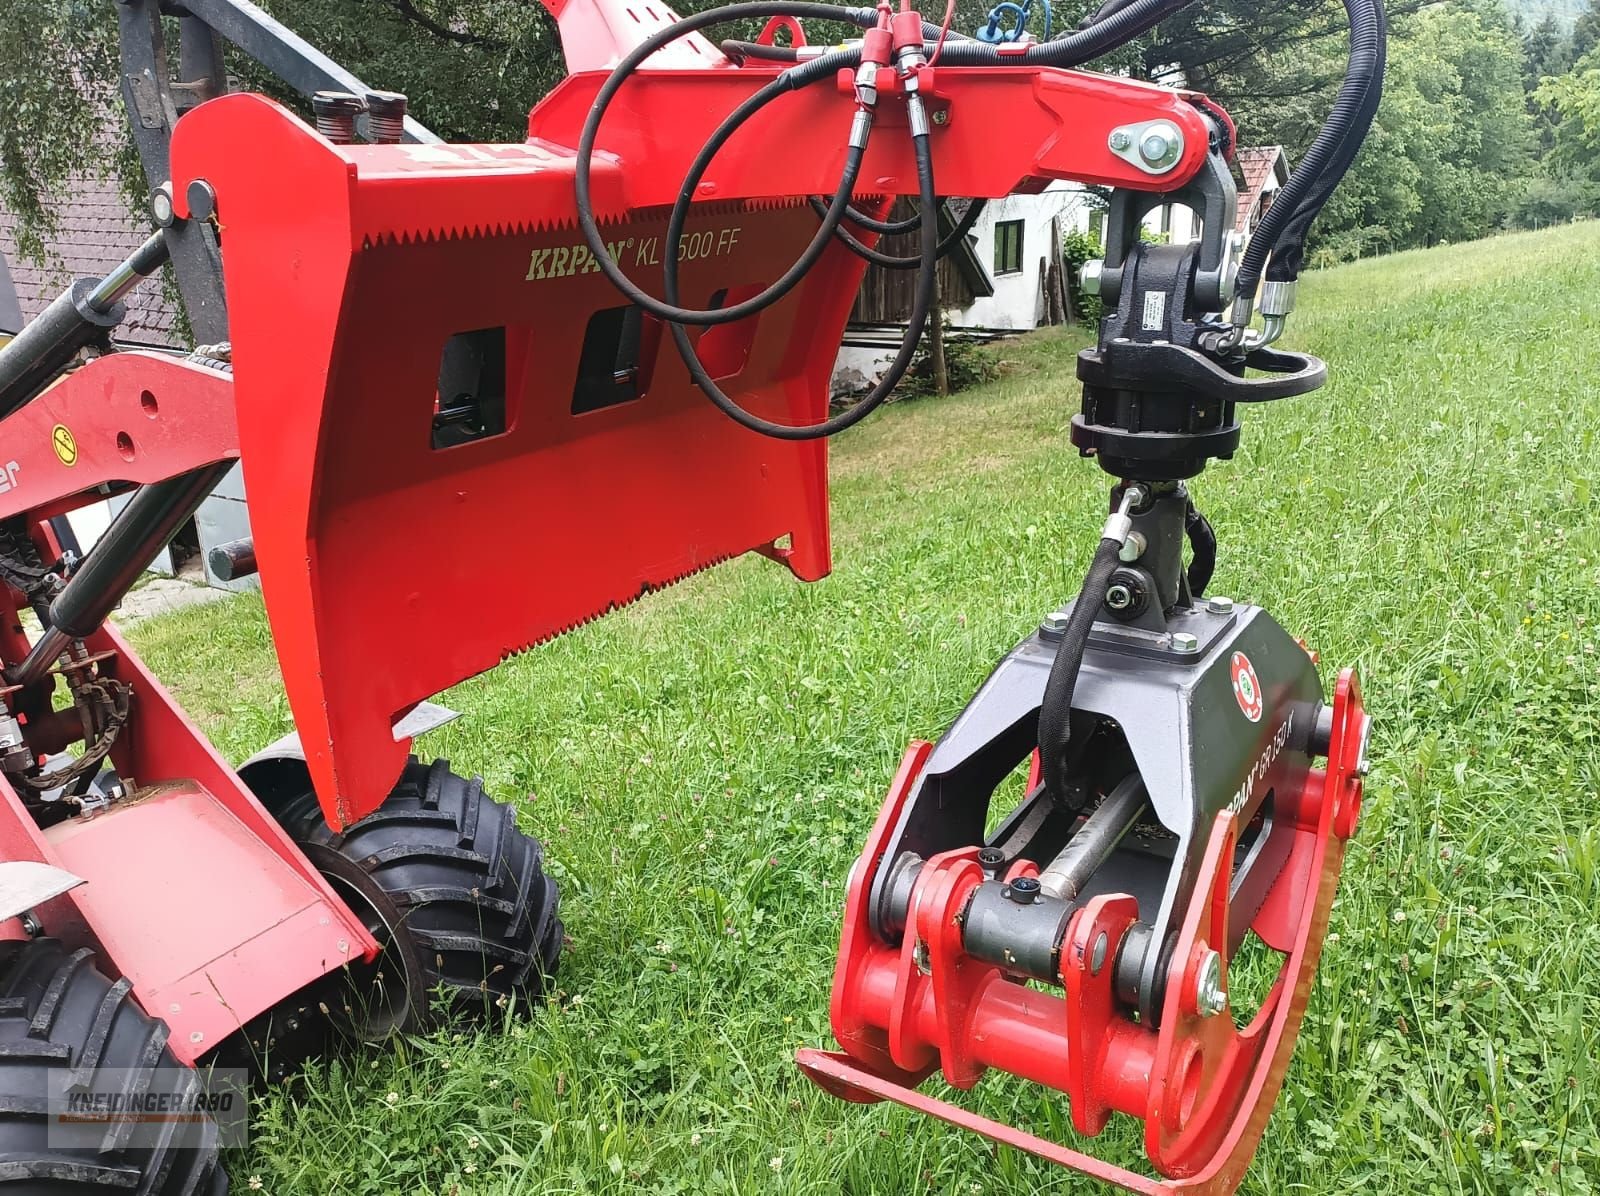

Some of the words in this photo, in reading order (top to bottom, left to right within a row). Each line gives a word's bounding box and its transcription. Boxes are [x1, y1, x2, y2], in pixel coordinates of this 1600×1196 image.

[635, 237, 660, 267] KL
[676, 230, 714, 263] 500
[716, 228, 742, 256] FF
[1258, 744, 1272, 780] GR
[1271, 721, 1287, 762] 150
[1287, 709, 1295, 739] K
